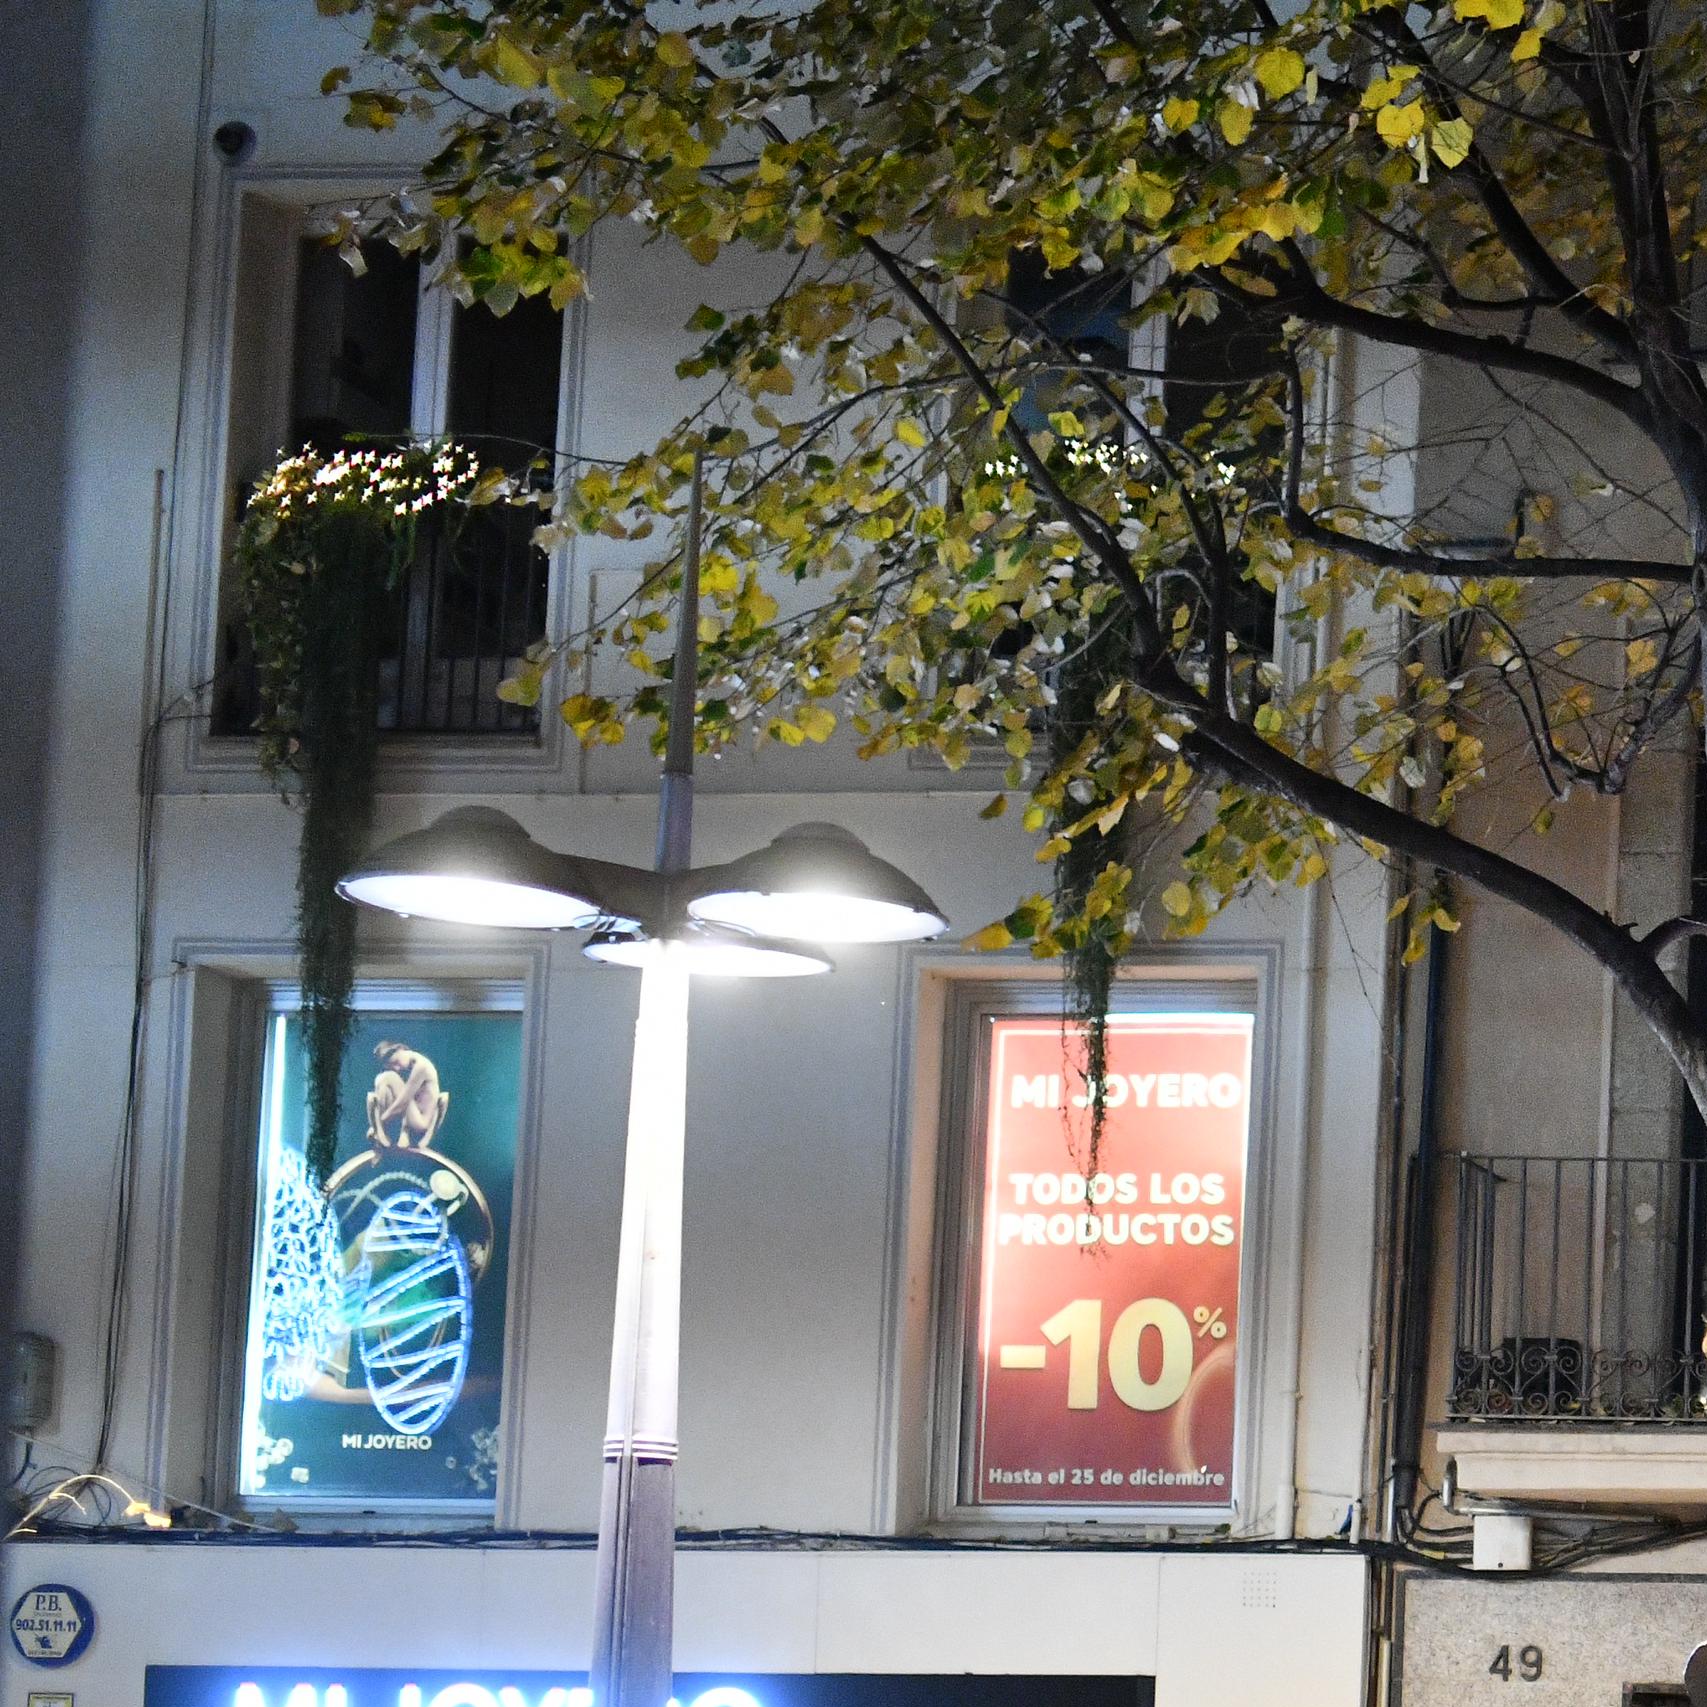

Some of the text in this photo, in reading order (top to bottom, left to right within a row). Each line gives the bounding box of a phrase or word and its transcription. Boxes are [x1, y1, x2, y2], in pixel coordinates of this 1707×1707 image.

[1010, 1072, 1241, 1109] MI JOYERO
[1009, 1173, 1225, 1205] TODOS LOS
[997, 1213, 1235, 1246] PRODUCTOS
[341, 1433, 432, 1450] MI JOYERO
[989, 1468, 1225, 1487] Hasta el 25 de diciembre
[1488, 1644, 1543, 1682] 49
